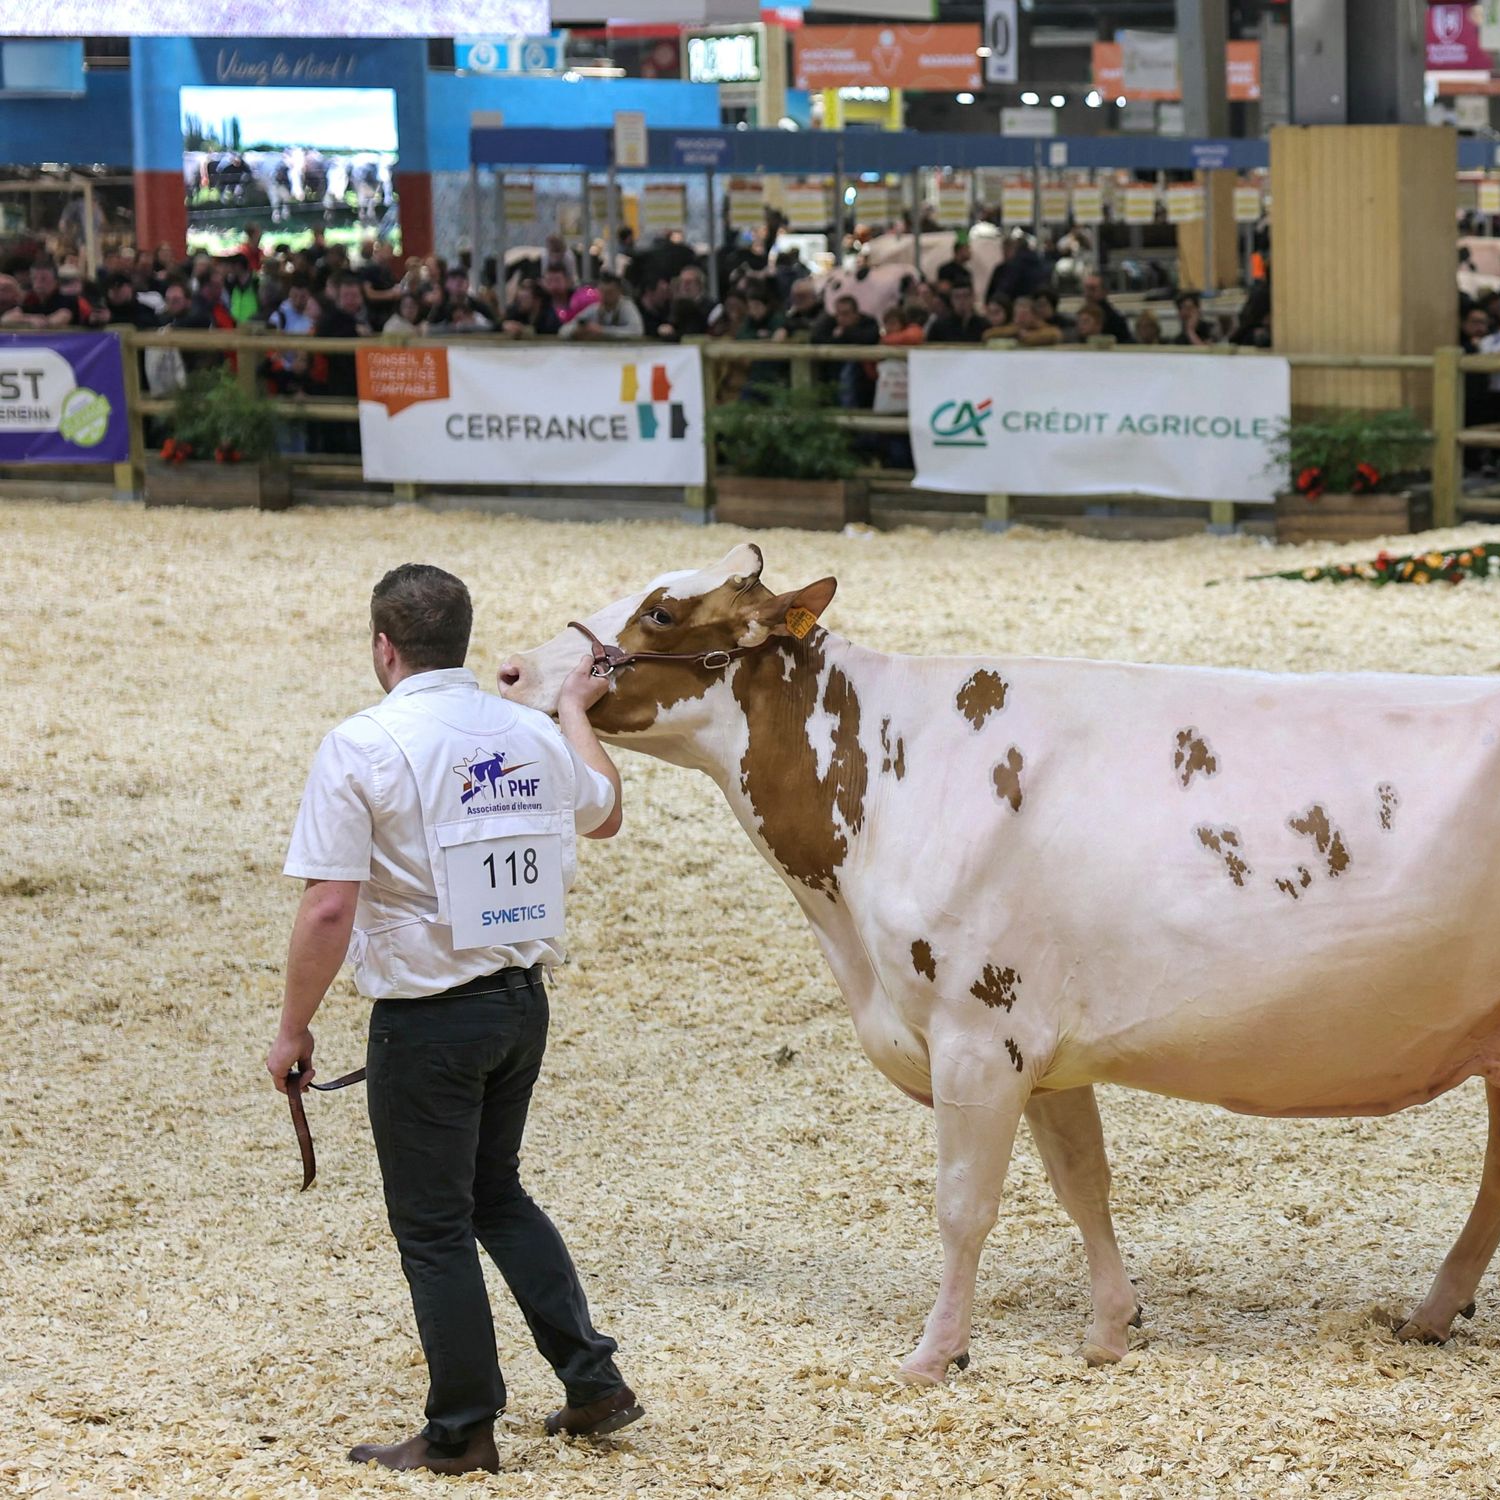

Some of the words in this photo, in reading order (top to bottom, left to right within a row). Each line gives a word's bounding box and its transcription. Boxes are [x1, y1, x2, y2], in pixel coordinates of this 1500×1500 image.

[445, 413, 629, 441] CERFRANCE
[1001, 407, 1110, 434] CRÉDIT
[1117, 412, 1271, 440] AGRICOLE
[507, 778, 540, 797] PHF
[467, 803, 511, 815] Association
[483, 847, 539, 889] 118
[481, 904, 546, 926] SYNETICS
